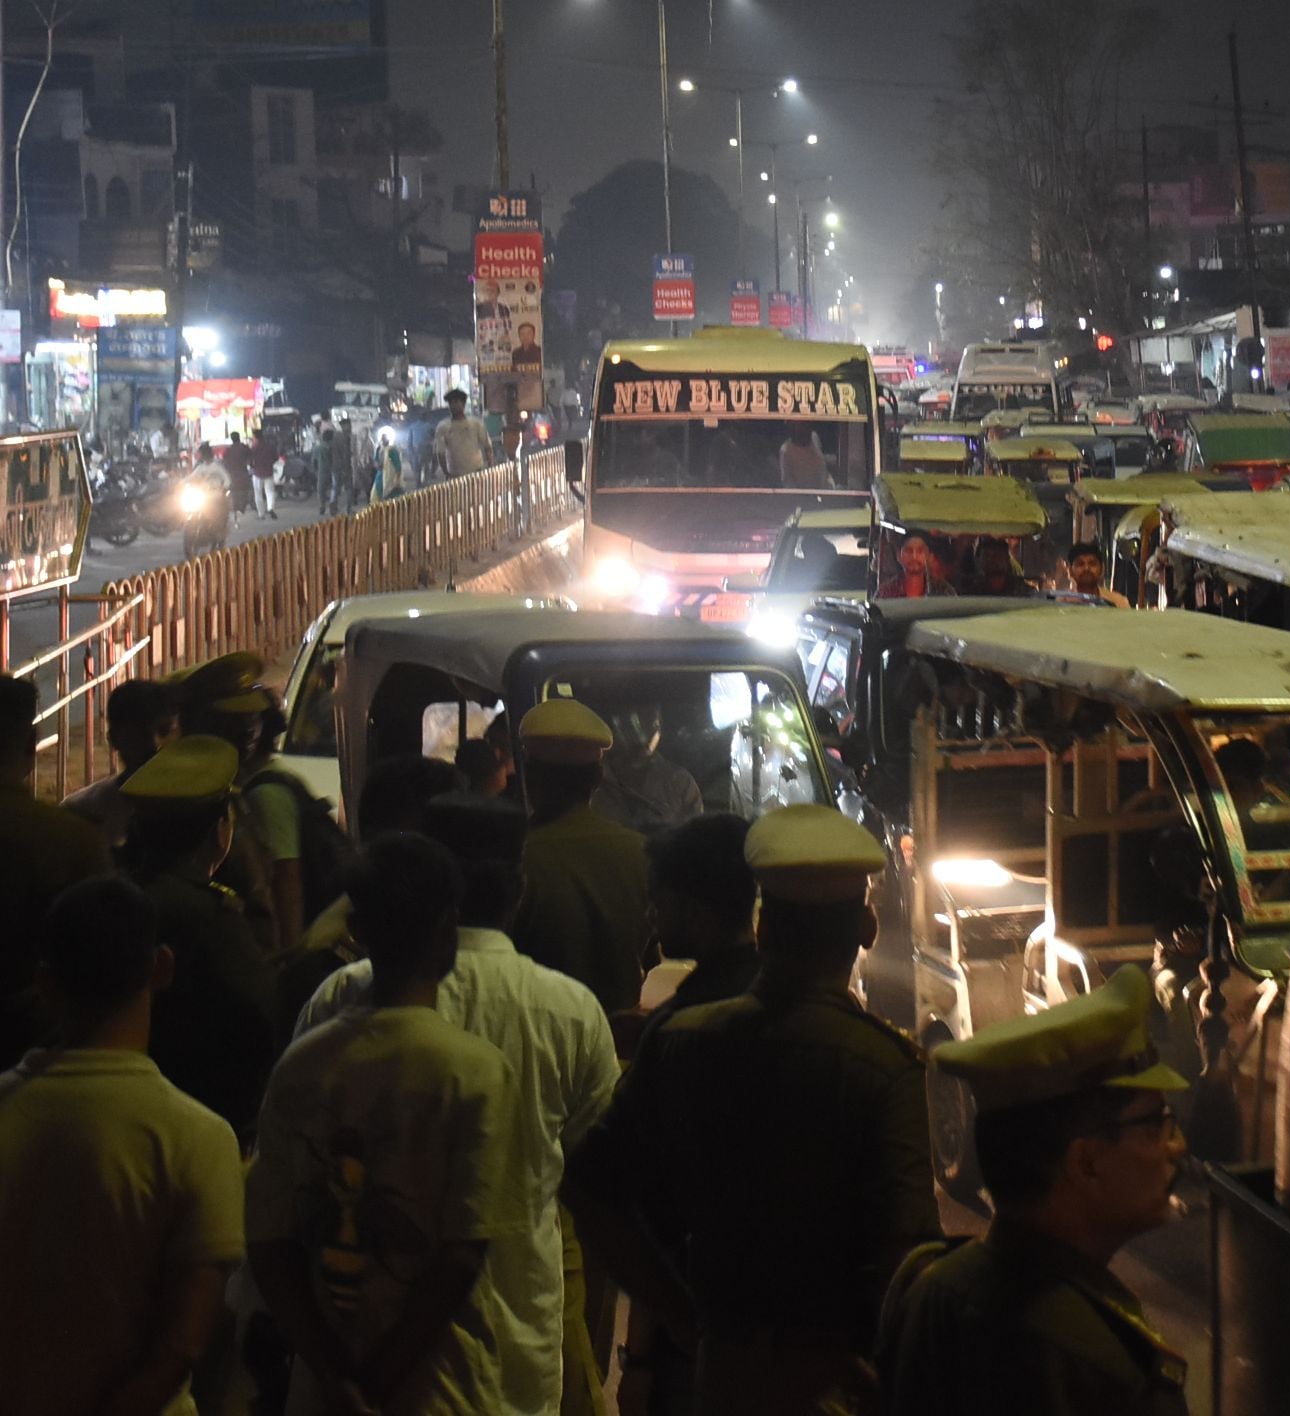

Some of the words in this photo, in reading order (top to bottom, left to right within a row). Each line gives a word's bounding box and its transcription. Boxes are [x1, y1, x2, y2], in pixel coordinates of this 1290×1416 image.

[481, 246, 537, 261] Health
[478, 263, 540, 278] Checks
[657, 287, 691, 298] Health
[655, 298, 693, 309] Checks
[612, 379, 682, 413] NEW
[689, 379, 770, 414] BLUE
[777, 380, 859, 416] STAR
